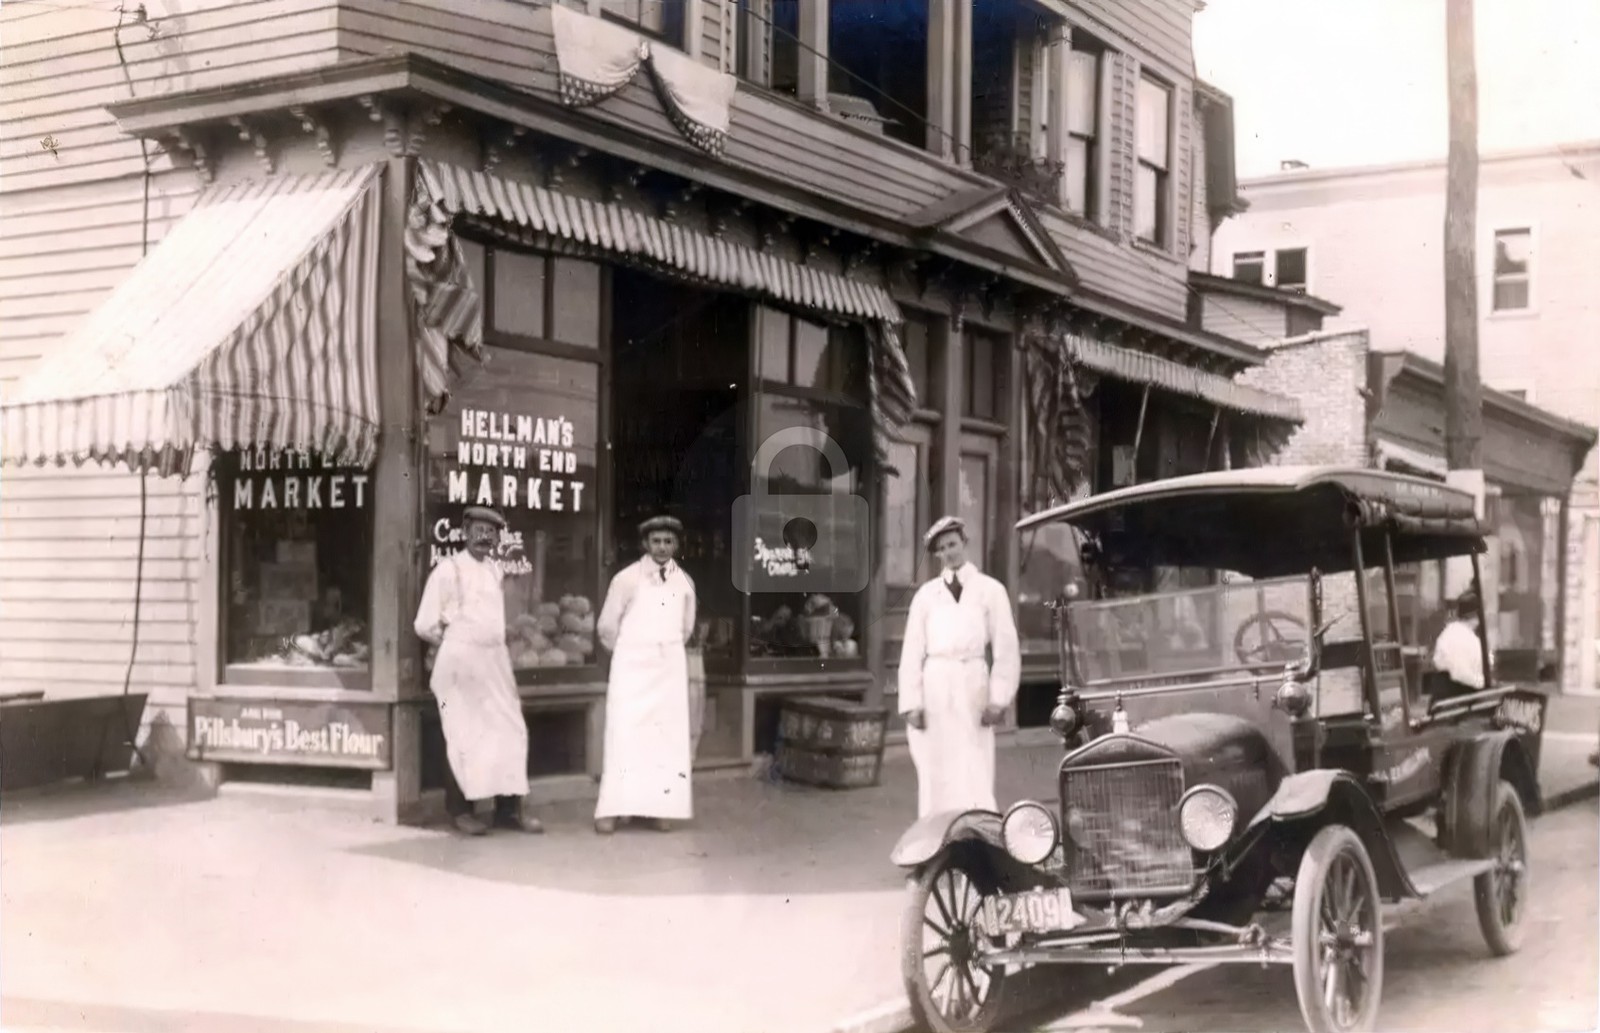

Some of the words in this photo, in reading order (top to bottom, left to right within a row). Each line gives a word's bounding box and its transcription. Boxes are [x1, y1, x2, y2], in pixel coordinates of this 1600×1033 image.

[461, 408, 574, 448] HELLMAN'S
[458, 441, 527, 470] NORTH
[539, 448, 577, 474] END
[234, 475, 368, 510] MARKET
[448, 470, 585, 512] MARKET
[195, 715, 284, 756] Pillsbury's
[285, 719, 329, 752] Best
[328, 721, 385, 755] Flour
